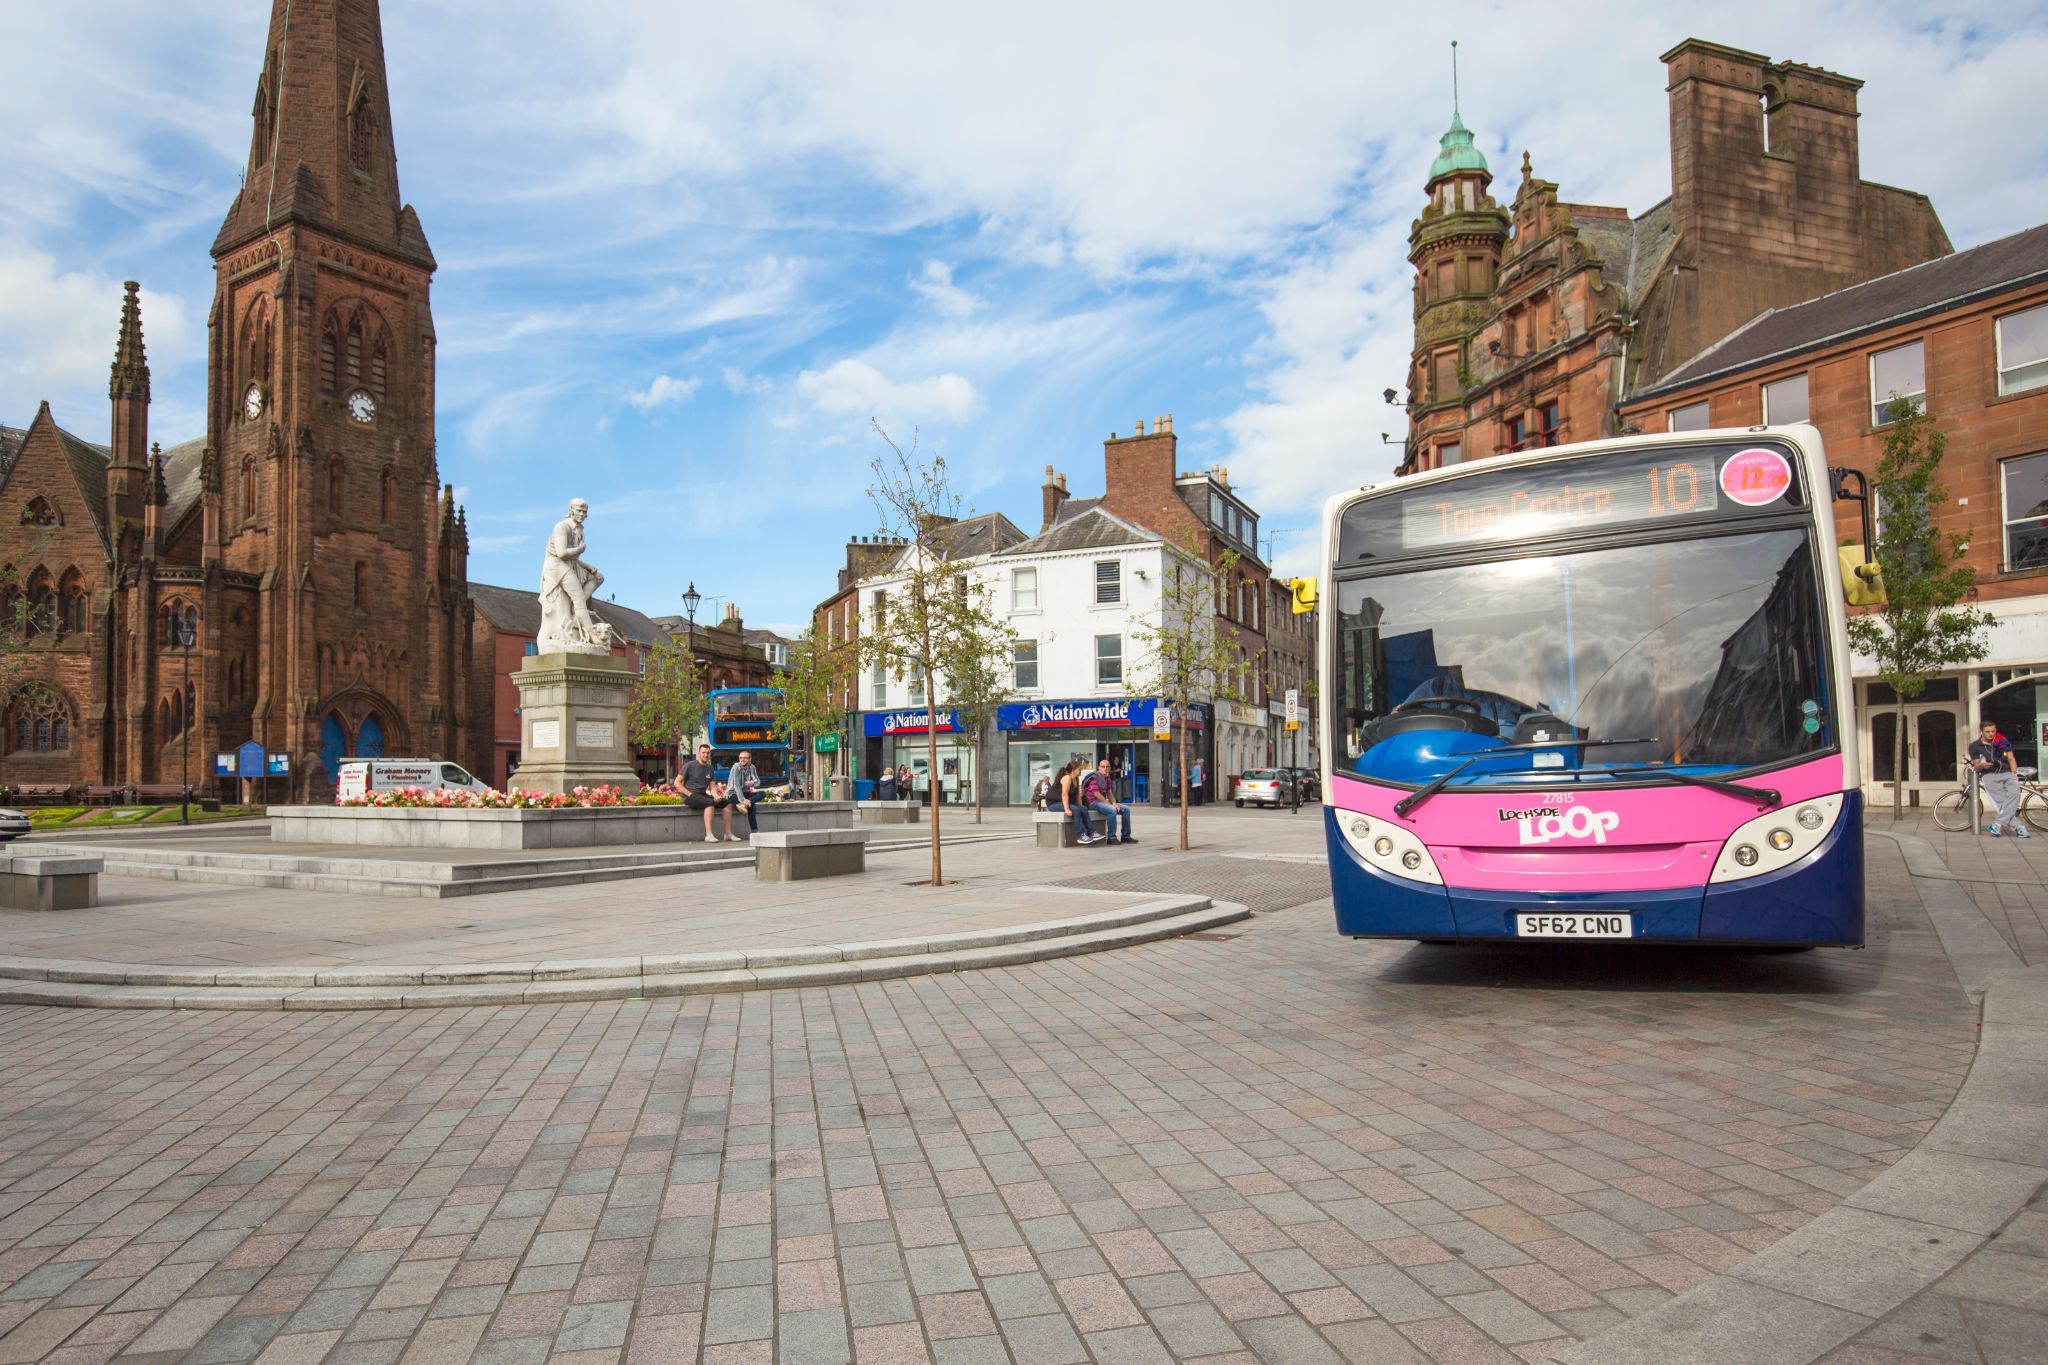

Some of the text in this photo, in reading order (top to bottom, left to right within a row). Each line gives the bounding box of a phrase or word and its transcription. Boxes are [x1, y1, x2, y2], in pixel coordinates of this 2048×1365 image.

[1737, 456, 1769, 464] weekly
[1645, 463, 1698, 514] 10
[1041, 702, 1129, 721] Nationwide
[895, 712, 952, 728] Nationide
[766, 730, 774, 740] 2
[375, 767, 432, 775] Graham Mooney
[1543, 792, 1575, 804] 27815
[1526, 917, 1622, 934] SF62 CNO
